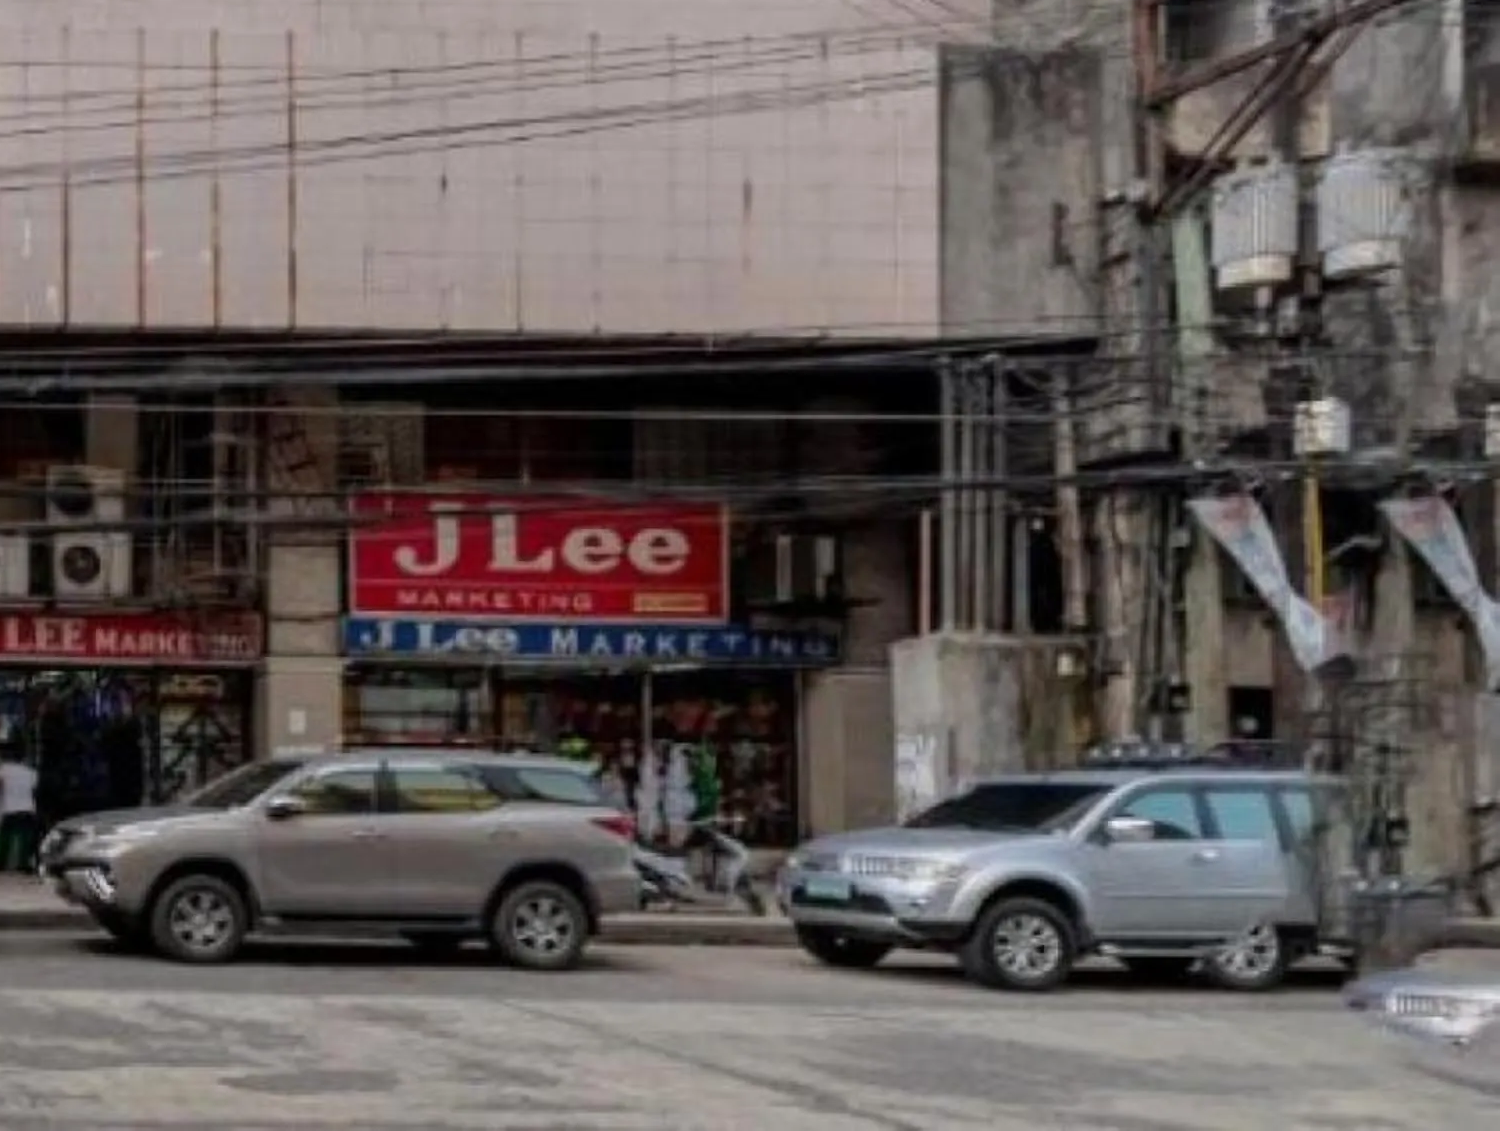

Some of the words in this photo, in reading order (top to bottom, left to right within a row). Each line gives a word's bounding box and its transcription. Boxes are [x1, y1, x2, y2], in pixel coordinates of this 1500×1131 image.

[393, 501, 465, 576] J
[485, 503, 691, 575] Lee
[396, 590, 595, 612] MARKETING
[3, 617, 88, 652] LEE
[95, 628, 258, 656] MARKENG
[415, 624, 520, 653] Lee
